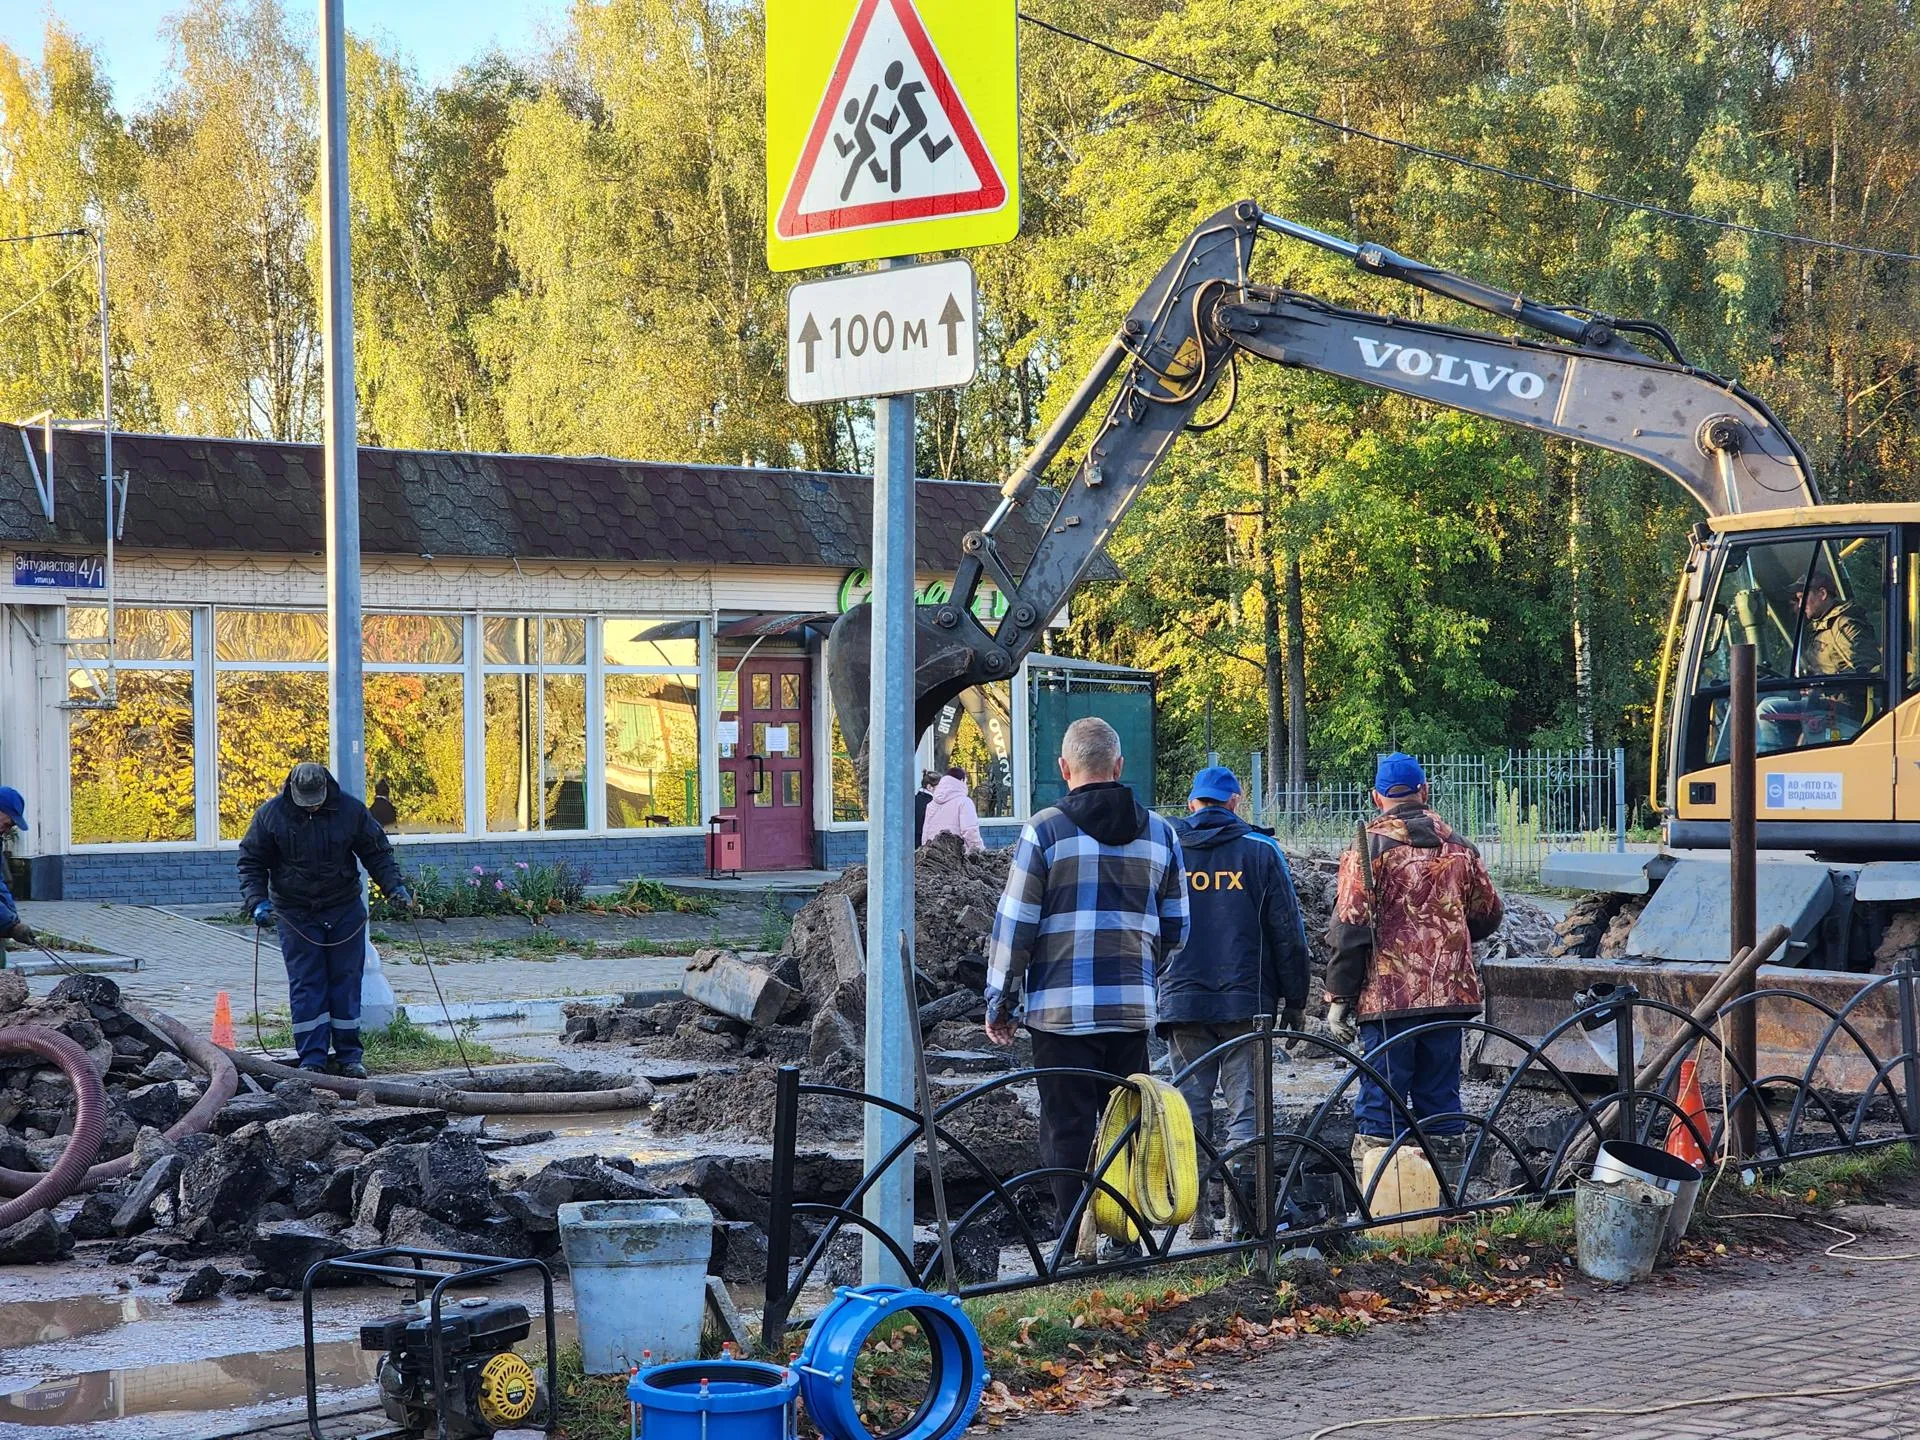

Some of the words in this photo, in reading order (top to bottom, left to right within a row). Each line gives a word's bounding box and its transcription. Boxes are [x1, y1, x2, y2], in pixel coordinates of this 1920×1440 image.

[829, 310, 895, 359] 100
[1353, 336, 1545, 400] VOLVO
[15, 555, 76, 574] Энтузиастов
[78, 558, 103, 587] 4/1
[1788, 791, 1837, 801] ВОДОКАНАЛ
[1214, 871, 1244, 891] ГХ
